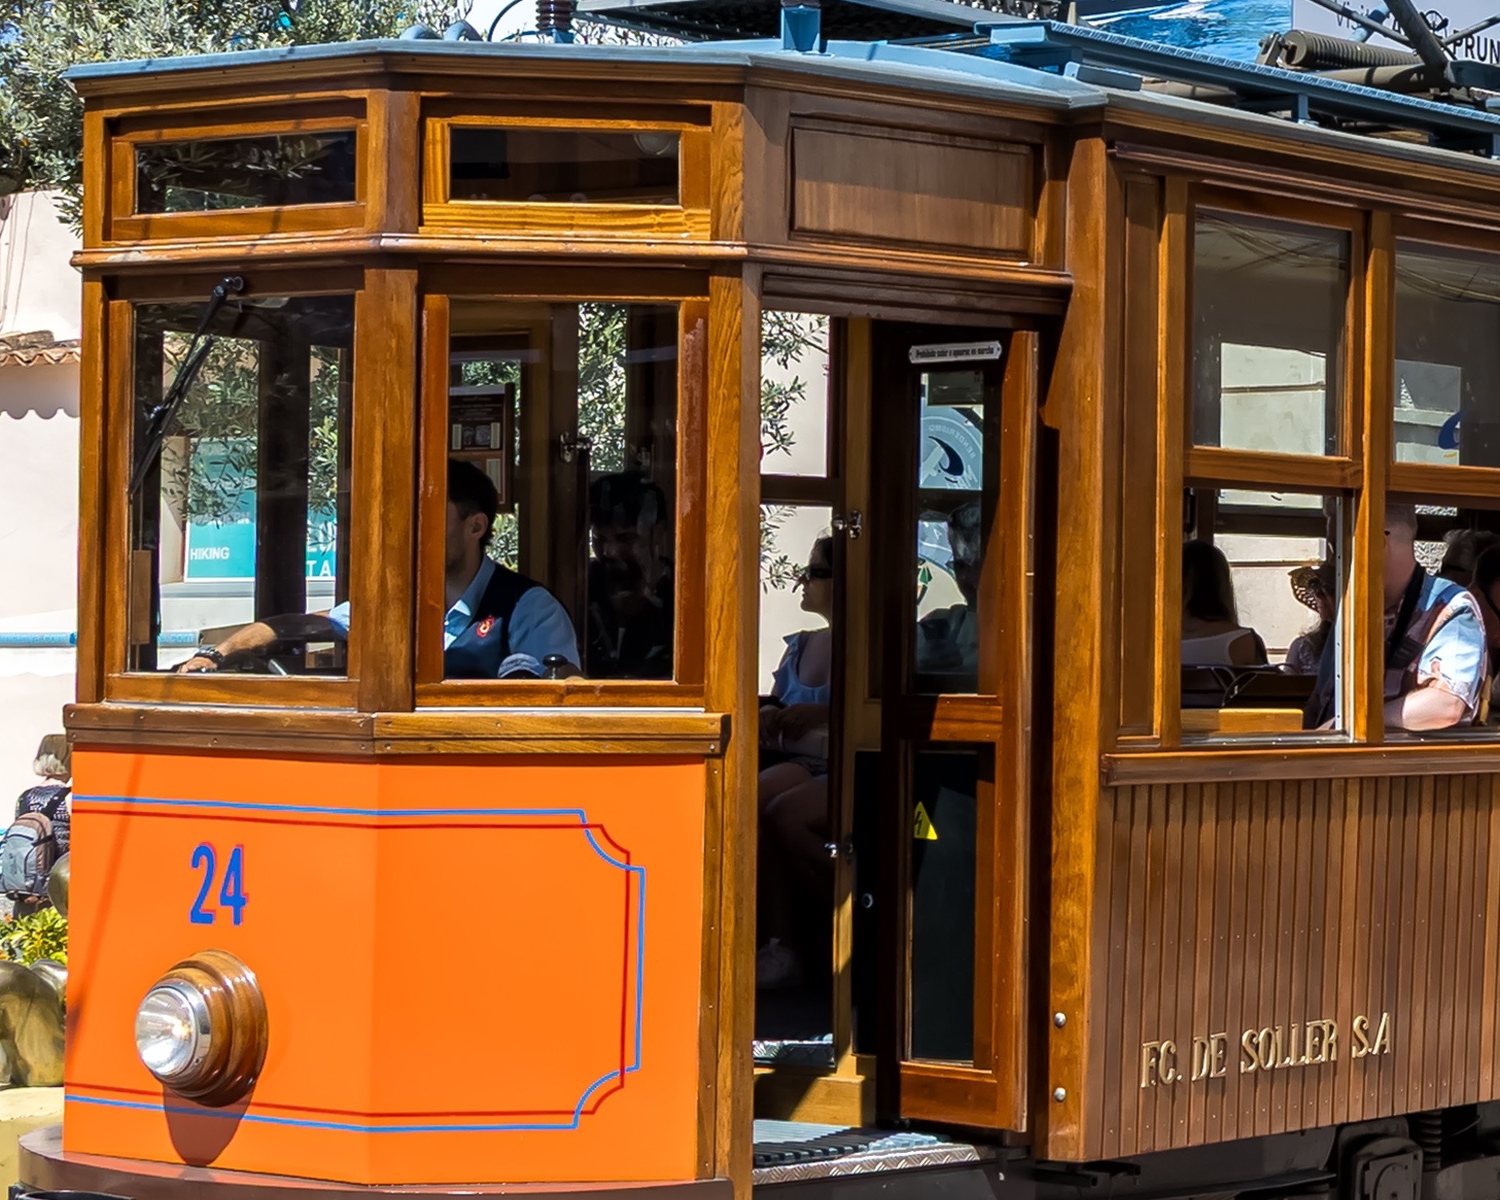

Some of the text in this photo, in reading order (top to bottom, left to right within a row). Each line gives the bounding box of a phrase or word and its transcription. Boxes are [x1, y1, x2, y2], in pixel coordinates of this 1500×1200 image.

[190, 547, 230, 561] HIKING
[189, 842, 248, 927] 24
[1140, 1039, 1183, 1088] F.C.
[1191, 1032, 1227, 1081] DE
[1240, 1018, 1338, 1074] SOLLER
